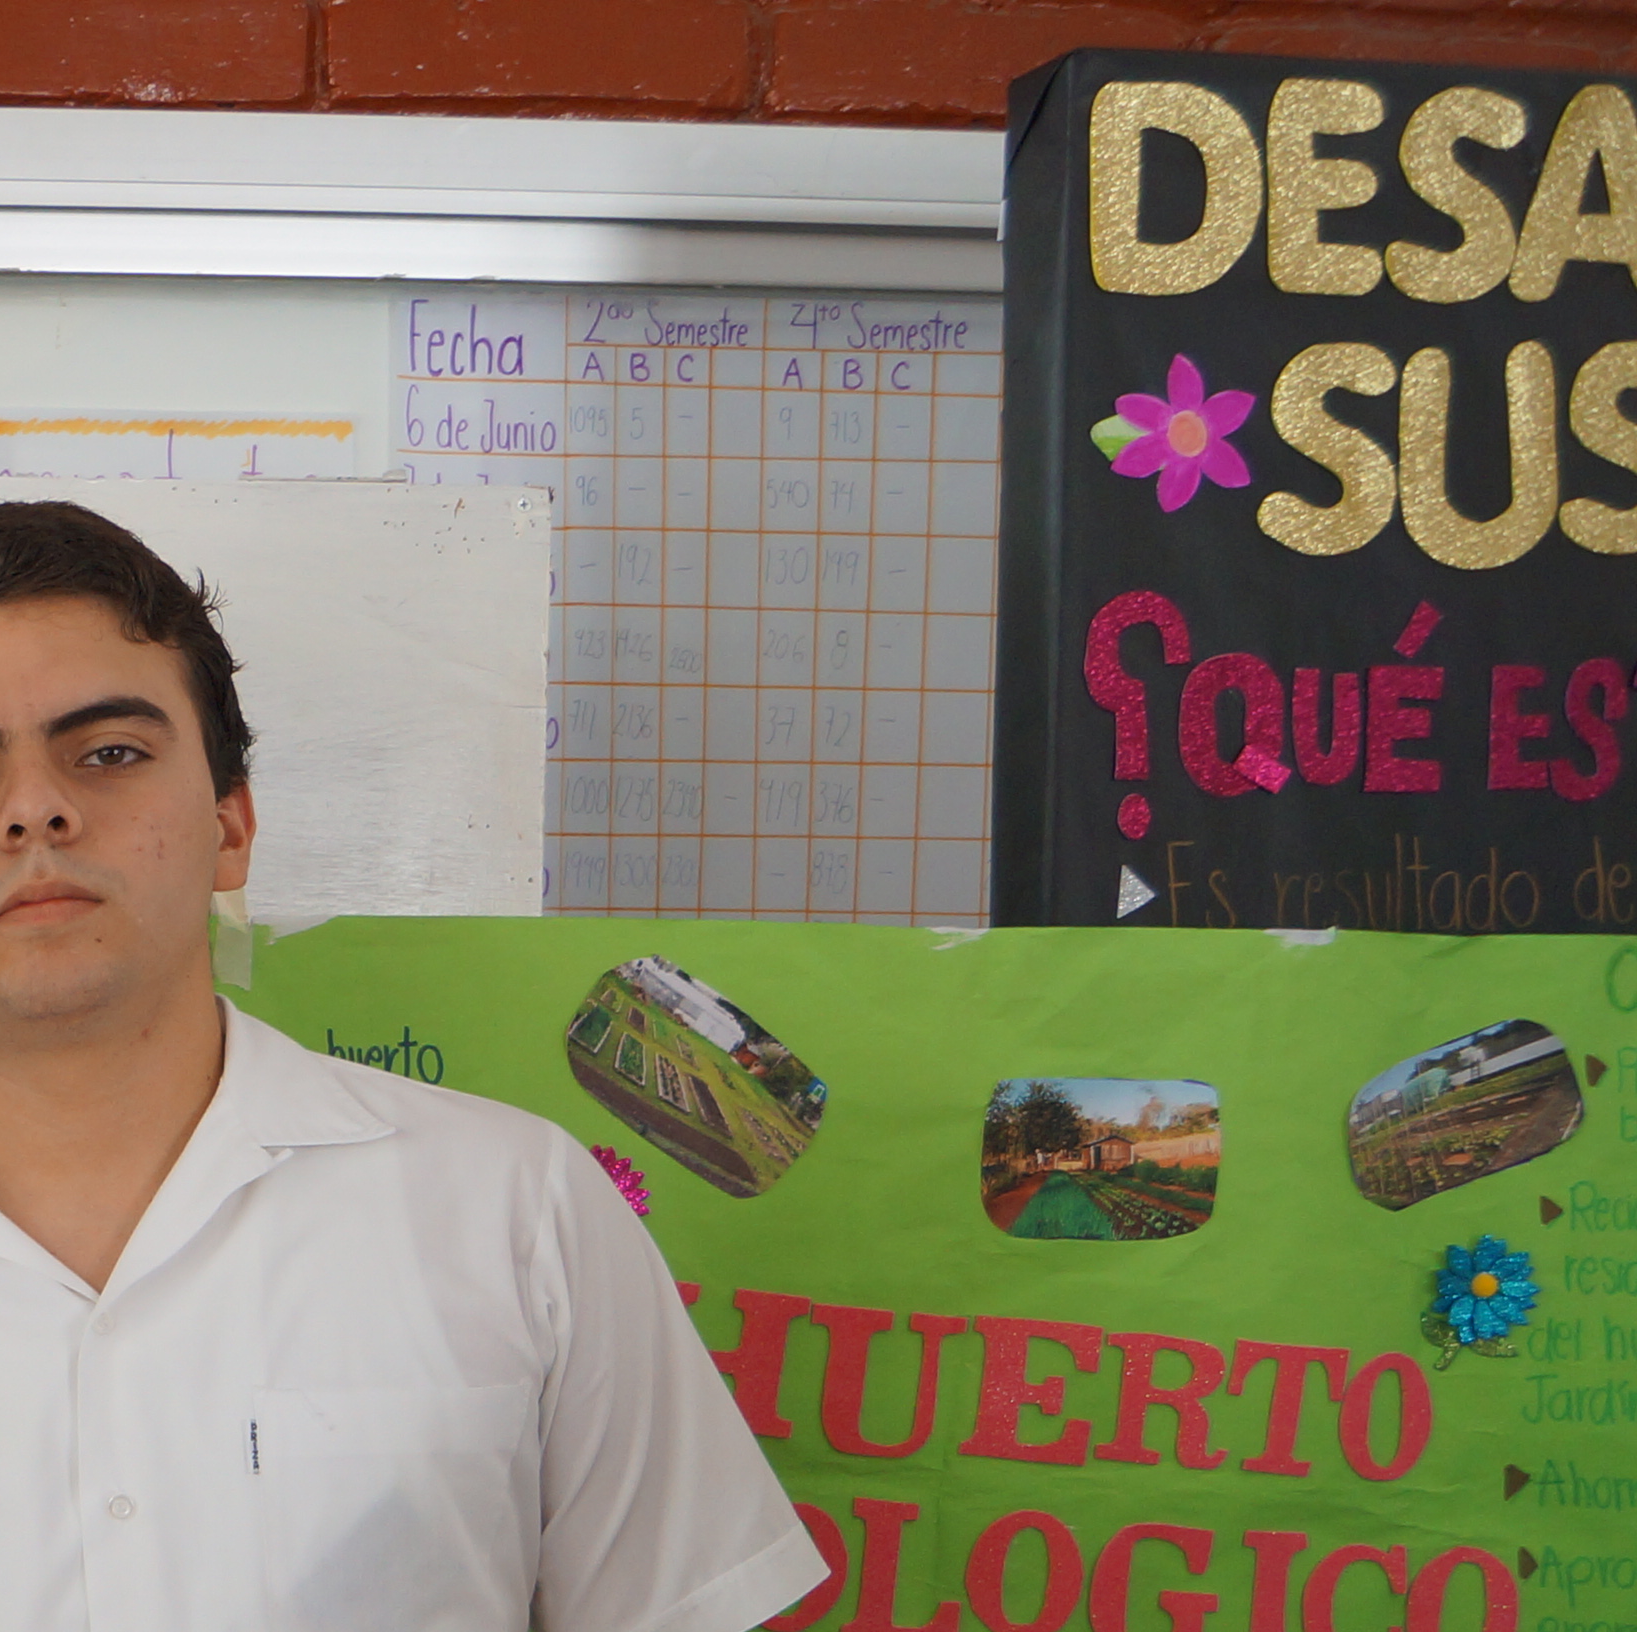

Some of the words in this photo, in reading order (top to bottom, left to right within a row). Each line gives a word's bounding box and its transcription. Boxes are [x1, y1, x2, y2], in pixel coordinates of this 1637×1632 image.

[1088, 77, 1637, 303] DESA
[406, 299, 525, 378] Fecha
[644, 303, 750, 348] Semestre
[848, 302, 968, 352] Semestre
[582, 357, 607, 382] A
[628, 355, 651, 383] B
[677, 354, 696, 383] C
[781, 358, 803, 390] A
[841, 359, 864, 390] B
[890, 361, 911, 391] C
[406, 385, 425, 446] 6
[435, 410, 469, 451] de
[480, 399, 557, 453] Junio
[630, 408, 644, 439] 5
[779, 407, 793, 440] 9
[1256, 339, 1637, 570] SUS
[575, 475, 598, 507] 96
[765, 545, 809, 587] 130
[1273, 832, 1541, 932] resultado
[1526, 1315, 1584, 1365] del
[673, 1280, 1434, 1483] HUERTO
